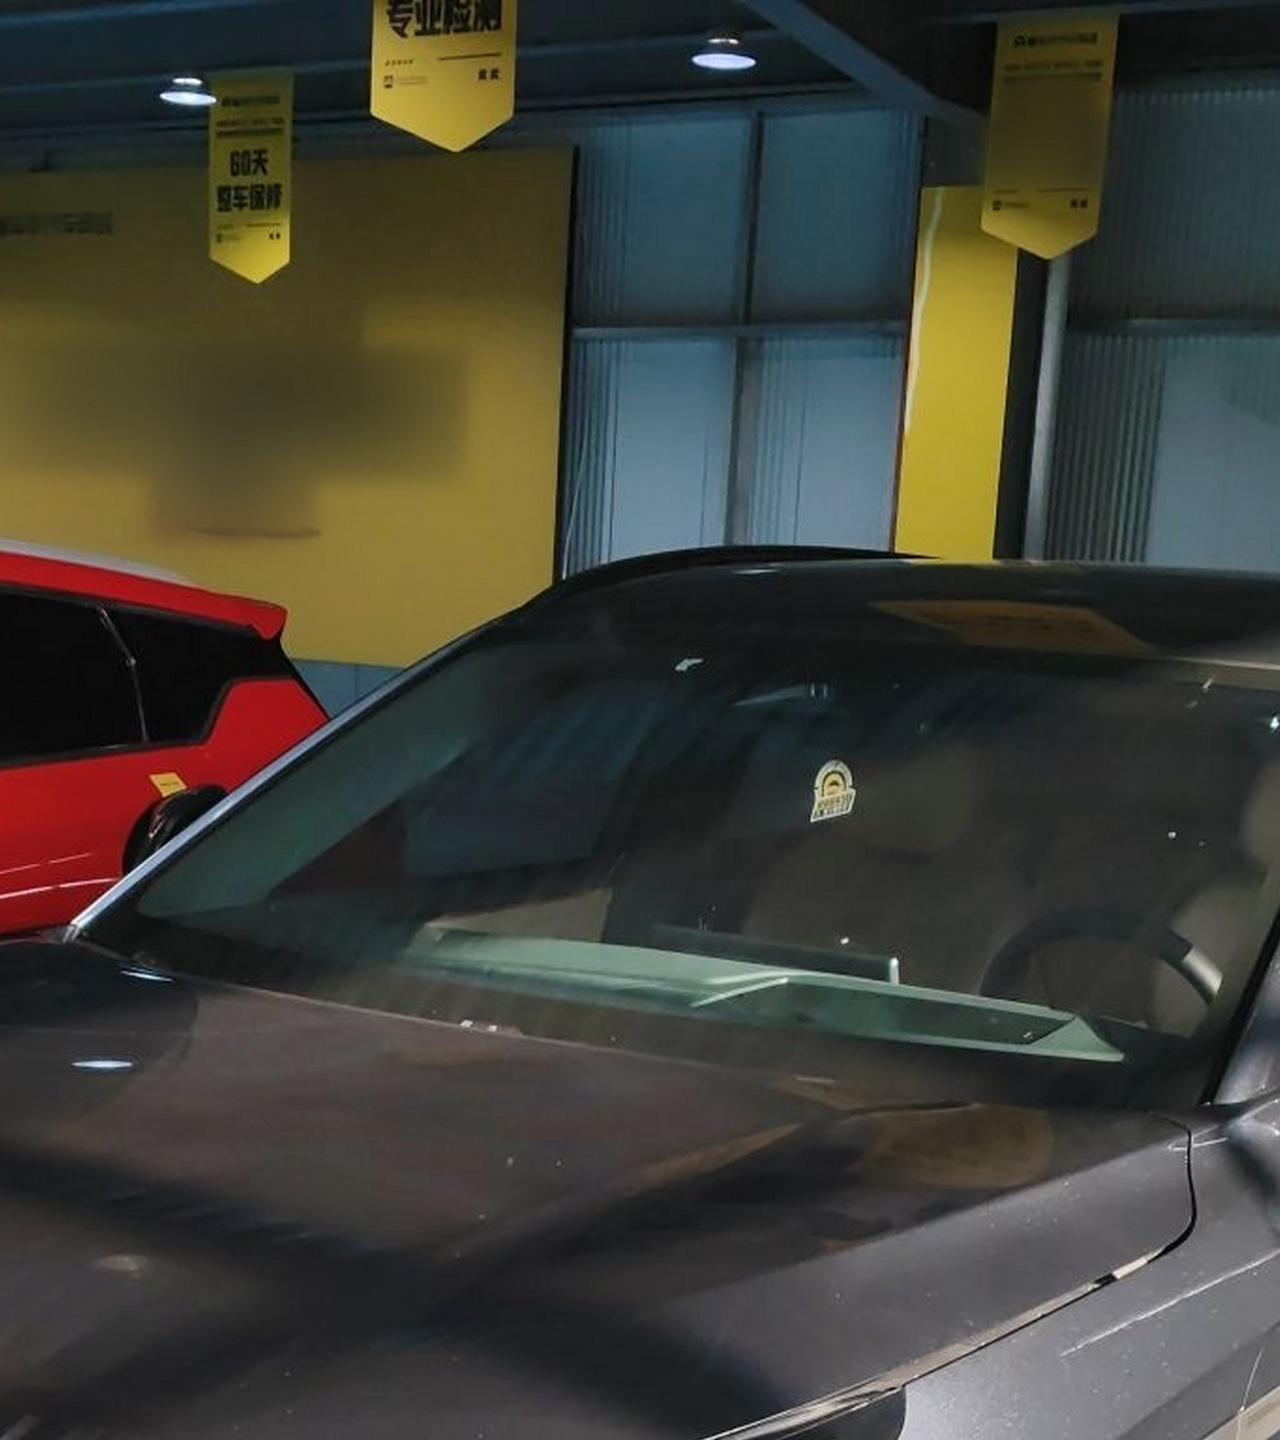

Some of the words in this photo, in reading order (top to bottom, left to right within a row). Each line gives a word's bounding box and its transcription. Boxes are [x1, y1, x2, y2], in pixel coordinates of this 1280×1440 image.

[386, 0, 502, 38] 专业检测
[230, 149, 269, 177] 60天
[216, 182, 283, 212] 整车保修
